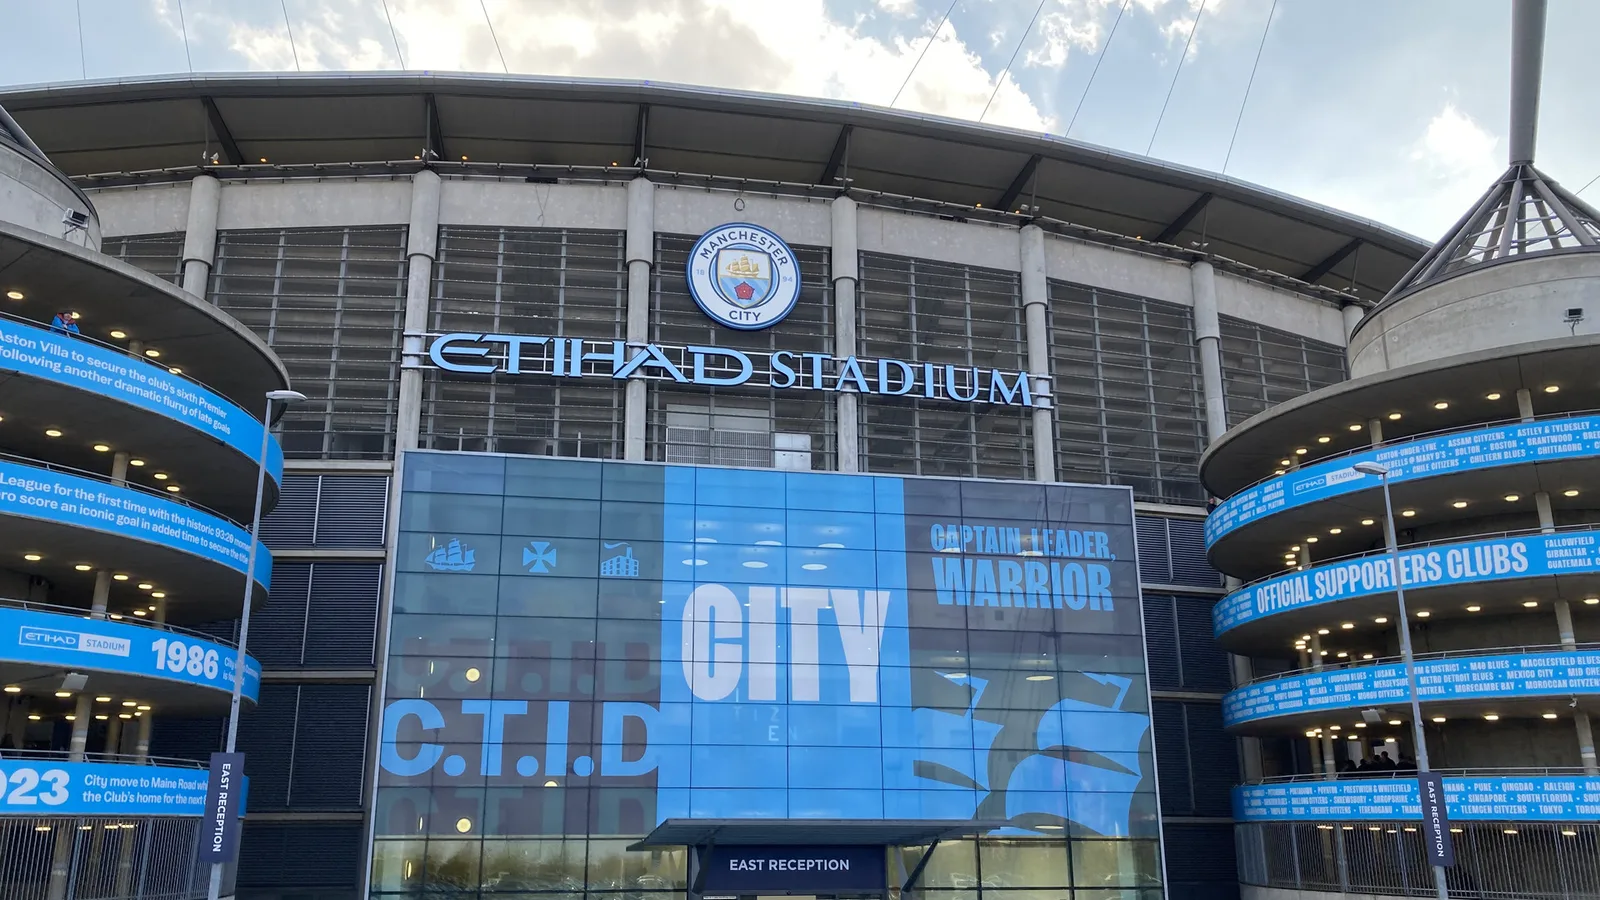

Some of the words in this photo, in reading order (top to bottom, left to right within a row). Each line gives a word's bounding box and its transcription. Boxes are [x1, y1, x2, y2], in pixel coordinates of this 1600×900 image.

[700, 231, 788, 266] MANCHESTER
[782, 275, 793, 283] 94
[729, 310, 761, 321] CITY
[40, 340, 69, 358] Villa
[71, 350, 85, 363] to
[87, 356, 126, 376] secure
[128, 368, 146, 383] the
[147, 376, 175, 395] club's
[176, 388, 198, 405] sixth
[198, 396, 228, 419] Premier
[429, 333, 755, 387] ETIHAD
[769, 350, 1033, 407] STADIUM
[0, 345, 62, 373] following
[64, 364, 113, 386] another
[114, 379, 161, 404] dramatic
[163, 395, 188, 416] flurry
[189, 406, 198, 418] of
[198, 409, 213, 425] late
[212, 419, 231, 435] goals
[1376, 442, 1437, 462] ASHTON-UNDER-LYNE
[1448, 435, 1472, 448] ASSAM
[1473, 431, 1506, 444] CITYZENS
[1517, 426, 1543, 437] ASTLEY
[1544, 425, 1550, 434] &
[1551, 421, 1590, 433] TYLDESLEY
[1408, 456, 1415, 464] @
[1415, 453, 1434, 463] MARY
[1455, 445, 1481, 457] BOLTON
[1490, 440, 1517, 451] BOSTON
[1527, 433, 1573, 446] BRANTWOOD
[1412, 464, 1431, 474] CHILE
[1470, 452, 1502, 464] CHILTERN
[1503, 449, 1526, 459] BLUES
[1537, 442, 1583, 455] CHITTAGONG
[1296, 478, 1325, 491] ETIHAD
[0, 472, 52, 492] League
[53, 483, 74, 497] for
[74, 488, 95, 502] the
[97, 492, 122, 508] first
[123, 499, 147, 515] time
[148, 506, 170, 522] with
[171, 513, 186, 527] the
[186, 516, 215, 536] historic
[0, 491, 17, 503] ro
[19, 495, 59, 510] score
[60, 502, 78, 514] an
[80, 504, 115, 521] iconic
[116, 513, 140, 528] goal
[141, 520, 151, 531] in
[152, 523, 181, 540] added
[181, 528, 200, 545] time
[200, 536, 209, 548] to
[209, 541, 230, 556] secure
[1032, 528, 1116, 562] LEADER,
[1545, 536, 1595, 548] FALLOWFIELD
[1546, 547, 1587, 559] GIBRALTAR
[1547, 557, 1593, 569] GUATEMALA
[931, 557, 1115, 612] WARRIOR
[1256, 575, 1313, 614] OFFICIAL
[1315, 551, 1443, 599] SUPPORTERS
[1446, 541, 1529, 579] CLUBS
[25, 632, 76, 645] ETIHAD
[86, 638, 125, 652] STADIUM
[681, 583, 891, 702] CITY
[151, 637, 220, 680] 1986
[1374, 668, 1396, 679] LUSAKA
[1404, 666, 1424, 676] LMM
[1430, 663, 1460, 673] DISTRICT
[1469, 661, 1487, 671] M40
[1487, 659, 1510, 670] BLUES
[1520, 656, 1576, 668] MACCLESFIELD
[1577, 655, 1600, 665] BLUES
[1373, 677, 1409, 689] MERSEYSIDE
[1420, 675, 1442, 685] METRO
[1443, 673, 1470, 683] DETROIT
[1472, 671, 1494, 681] BLUES
[1506, 669, 1536, 679] MEXICO
[1537, 668, 1554, 678] CITY
[1567, 667, 1584, 677] MID
[1585, 667, 1600, 676] CHE
[1377, 688, 1404, 699] CITYZENS
[1455, 683, 1500, 693] MORECAMBE
[1500, 682, 1515, 691] BAY
[1525, 679, 1568, 690] MOROCCAN
[1569, 678, 1600, 688] CITYZEN
[380, 698, 660, 777] C.T.I.D
[84, 774, 108, 789] City
[109, 777, 139, 788] move
[139, 777, 150, 788] to
[151, 776, 177, 789] Maine
[178, 778, 197, 790] Road
[196, 780, 209, 791] whi
[220, 763, 231, 789] EAST
[1378, 783, 1412, 793] WHITEFIELD
[1474, 782, 1492, 792] PUNE
[1501, 782, 1534, 792] QINGDAO
[1544, 782, 1576, 792] RALEIGH
[82, 790, 102, 803] the
[103, 790, 135, 803] Club's
[136, 791, 162, 804] home
[163, 792, 175, 804] for
[175, 793, 188, 805] the
[188, 796, 203, 805] next
[1427, 781, 1437, 804] EAST
[1468, 793, 1507, 803] SINGAPORE
[1516, 793, 1542, 803] SOUTH
[1541, 793, 1574, 803] FLORIDA
[1584, 793, 1600, 803] SOU
[212, 792, 228, 852] RECEPTION
[1401, 805, 1423, 814] THAME
[1493, 805, 1528, 815] CITYZENS
[1538, 805, 1564, 815] TOKYO
[1575, 805, 1600, 815] TORON
[1431, 806, 1445, 857] RECEPTION
[729, 859, 765, 871] EAST
[769, 859, 850, 871] RECEPTION
